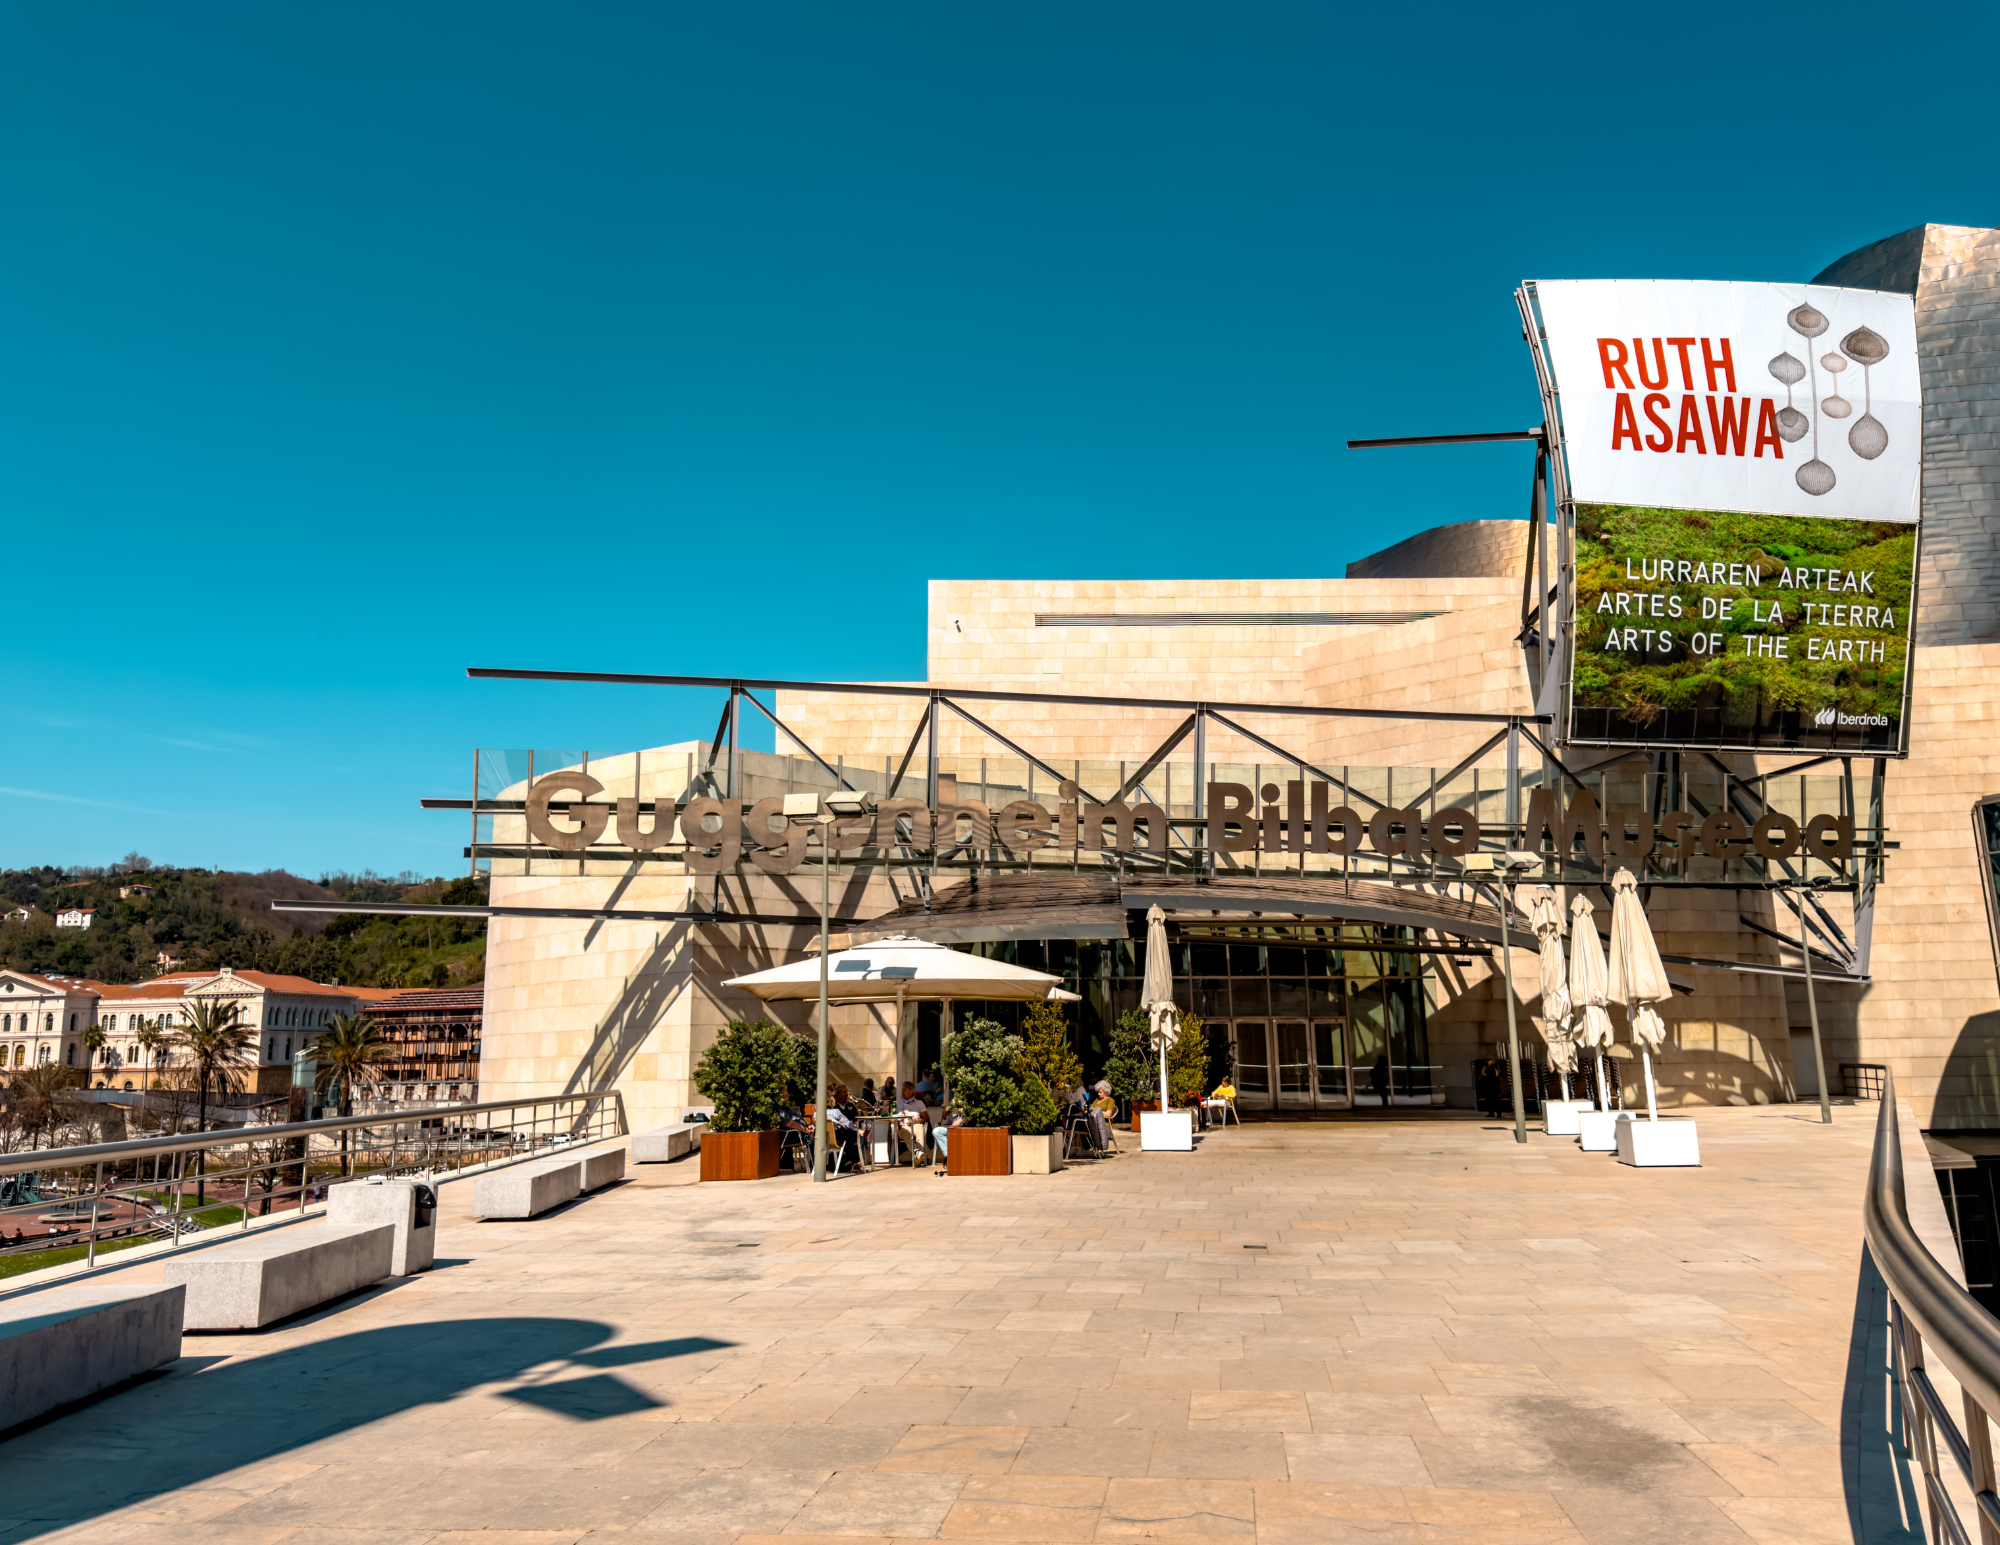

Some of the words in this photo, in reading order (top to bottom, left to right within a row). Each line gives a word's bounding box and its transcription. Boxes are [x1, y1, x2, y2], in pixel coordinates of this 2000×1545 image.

[1596, 337, 1737, 393] RUTH
[1611, 392, 1784, 459] ASAWA
[1626, 557, 1761, 587] LURRAREN
[1778, 566, 1875, 594] ARTEAK
[1596, 591, 1683, 618] ARTES
[1702, 597, 1733, 621] DE
[1754, 600, 1784, 624] LA
[1803, 602, 1895, 629] TIERRA
[1604, 628, 1673, 653] ARTS
[1691, 632, 1723, 655] OF
[1742, 634, 1789, 659] THE
[1807, 638, 1885, 662] EARTH
[1837, 712, 1889, 727] Iberdrola
[524, 770, 1167, 873] Guggenheim
[1207, 780, 1480, 858] Bilbao
[1523, 787, 1854, 861] Museoa
[991, 1005, 1011, 1015] BAR
